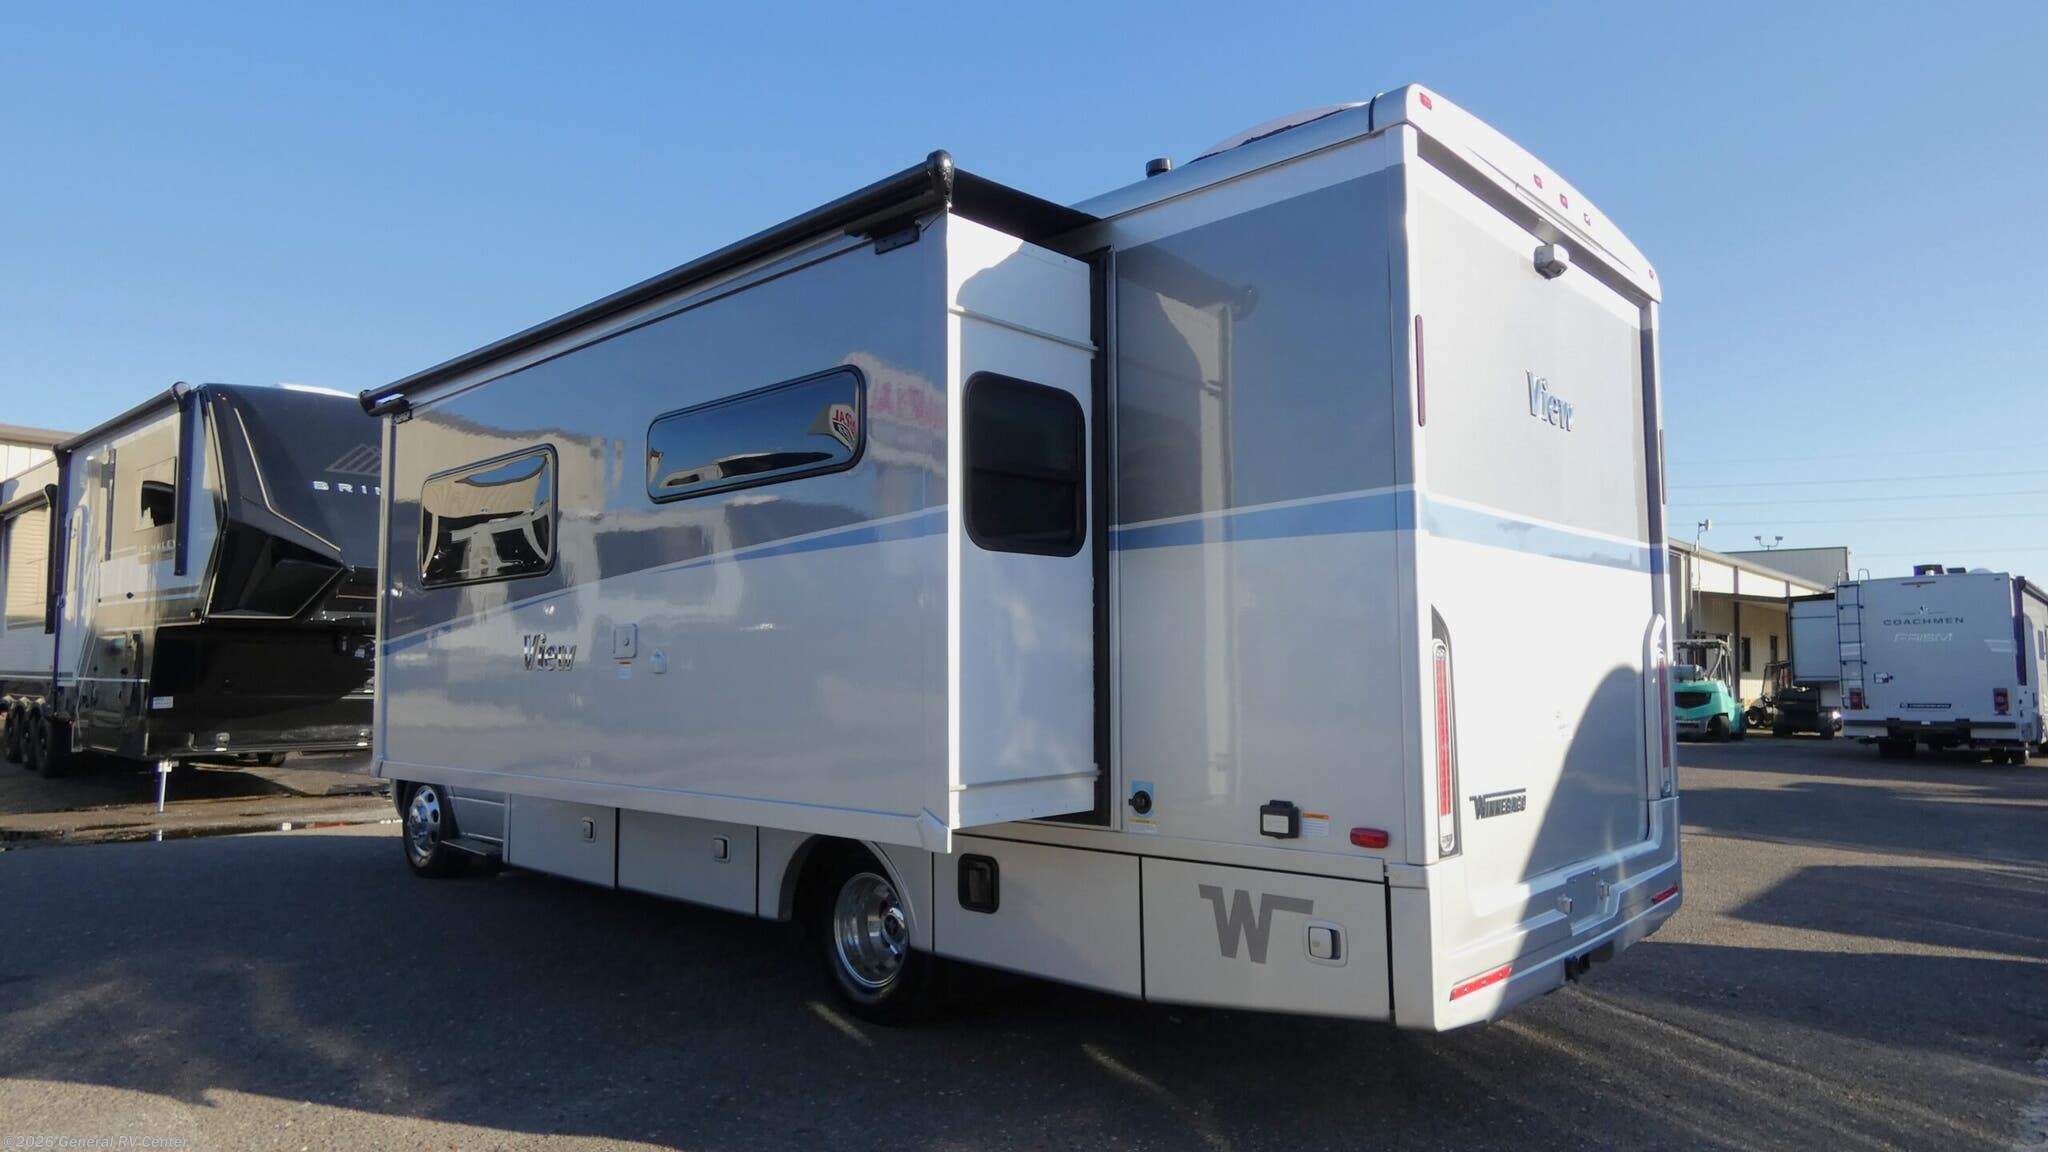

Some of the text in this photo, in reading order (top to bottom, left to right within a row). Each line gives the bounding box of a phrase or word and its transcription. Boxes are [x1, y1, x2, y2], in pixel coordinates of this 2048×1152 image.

[1525, 369, 1574, 432] View
[1883, 617, 1964, 626] COACHMEN
[523, 632, 578, 672] View
